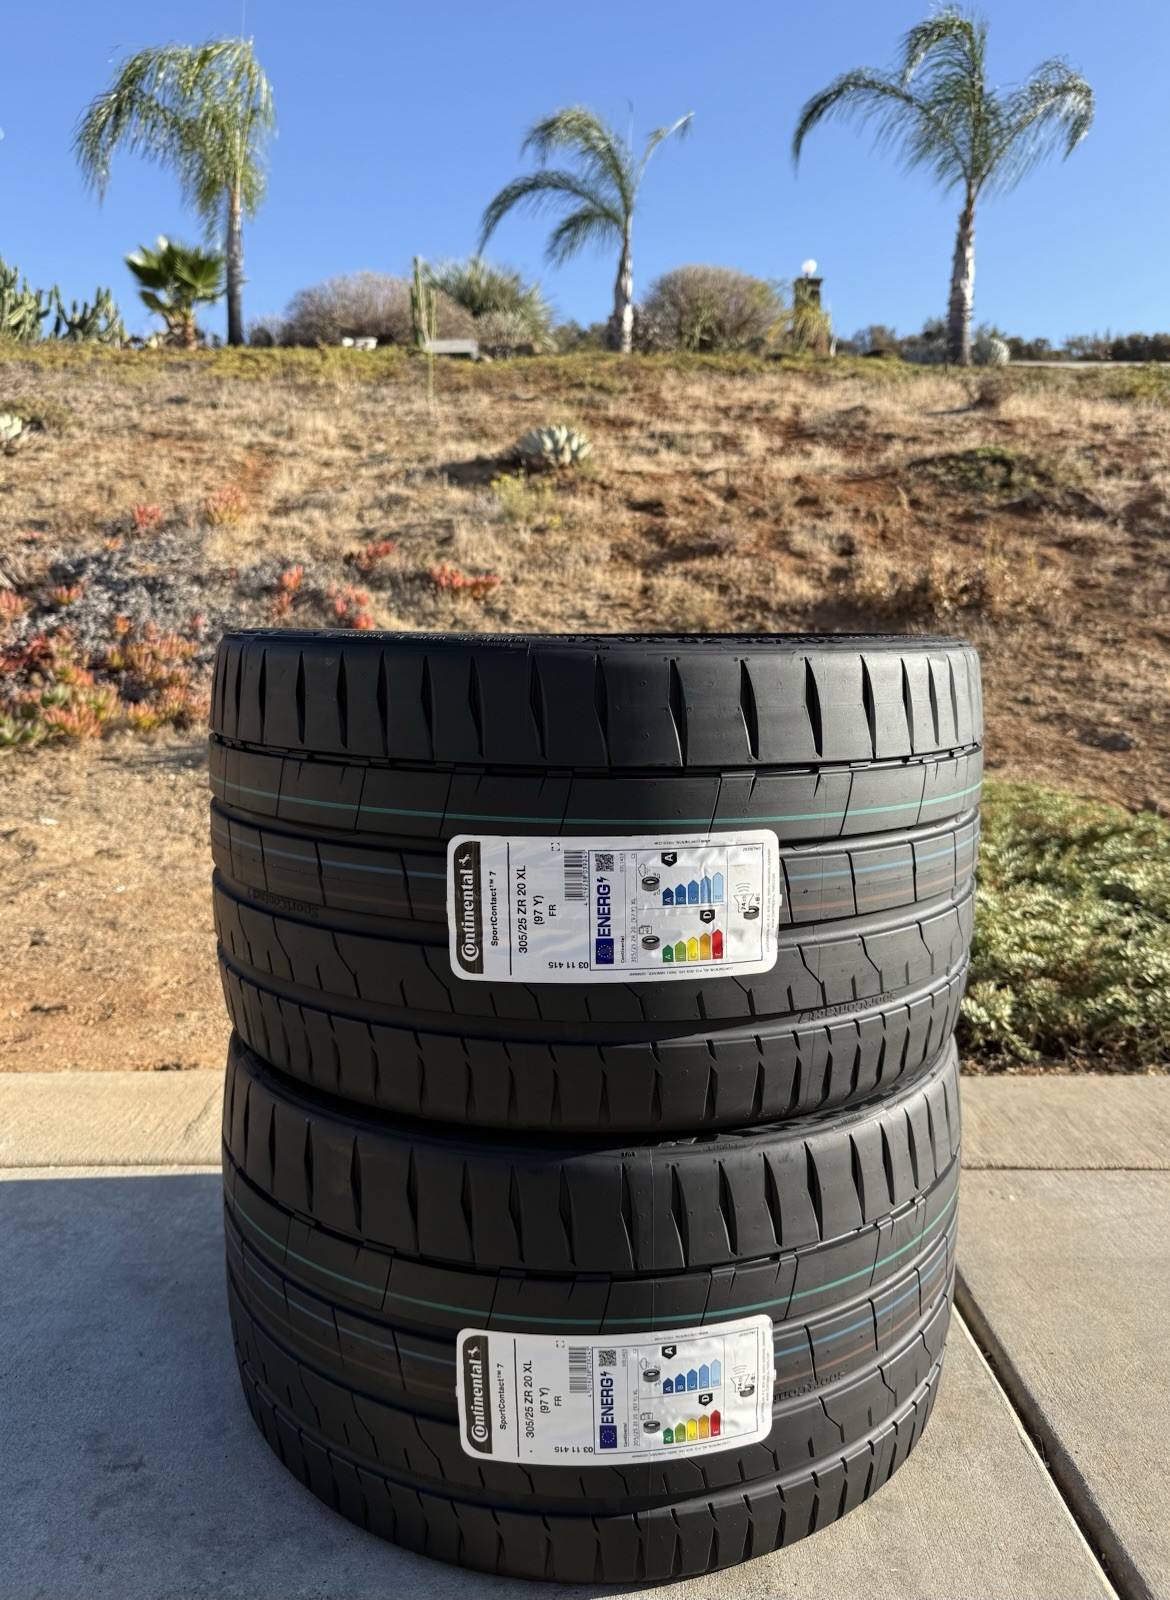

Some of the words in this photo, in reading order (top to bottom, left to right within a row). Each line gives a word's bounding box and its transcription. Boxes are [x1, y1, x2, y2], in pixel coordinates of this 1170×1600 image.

[664, 853, 674, 862] A
[516, 865, 526, 880] XL
[517, 882, 526, 896] 20
[517, 899, 527, 915] ZR
[533, 895, 544, 906] Y)
[460, 868, 479, 962] Continental
[548, 904, 556, 917] FR
[702, 911, 712, 920] D
[533, 910, 544, 926] (97
[517, 916, 528, 954] 305/25
[664, 1346, 674, 1354] A
[523, 1360, 532, 1374] XL
[524, 1375, 532, 1388] 20
[468, 1357, 488, 1442] Continental
[524, 1390, 534, 1404] ZR
[540, 1387, 550, 1398] Y)
[540, 1400, 550, 1414] (97
[554, 1396, 562, 1407] FR
[524, 1405, 535, 1438] 305/25
